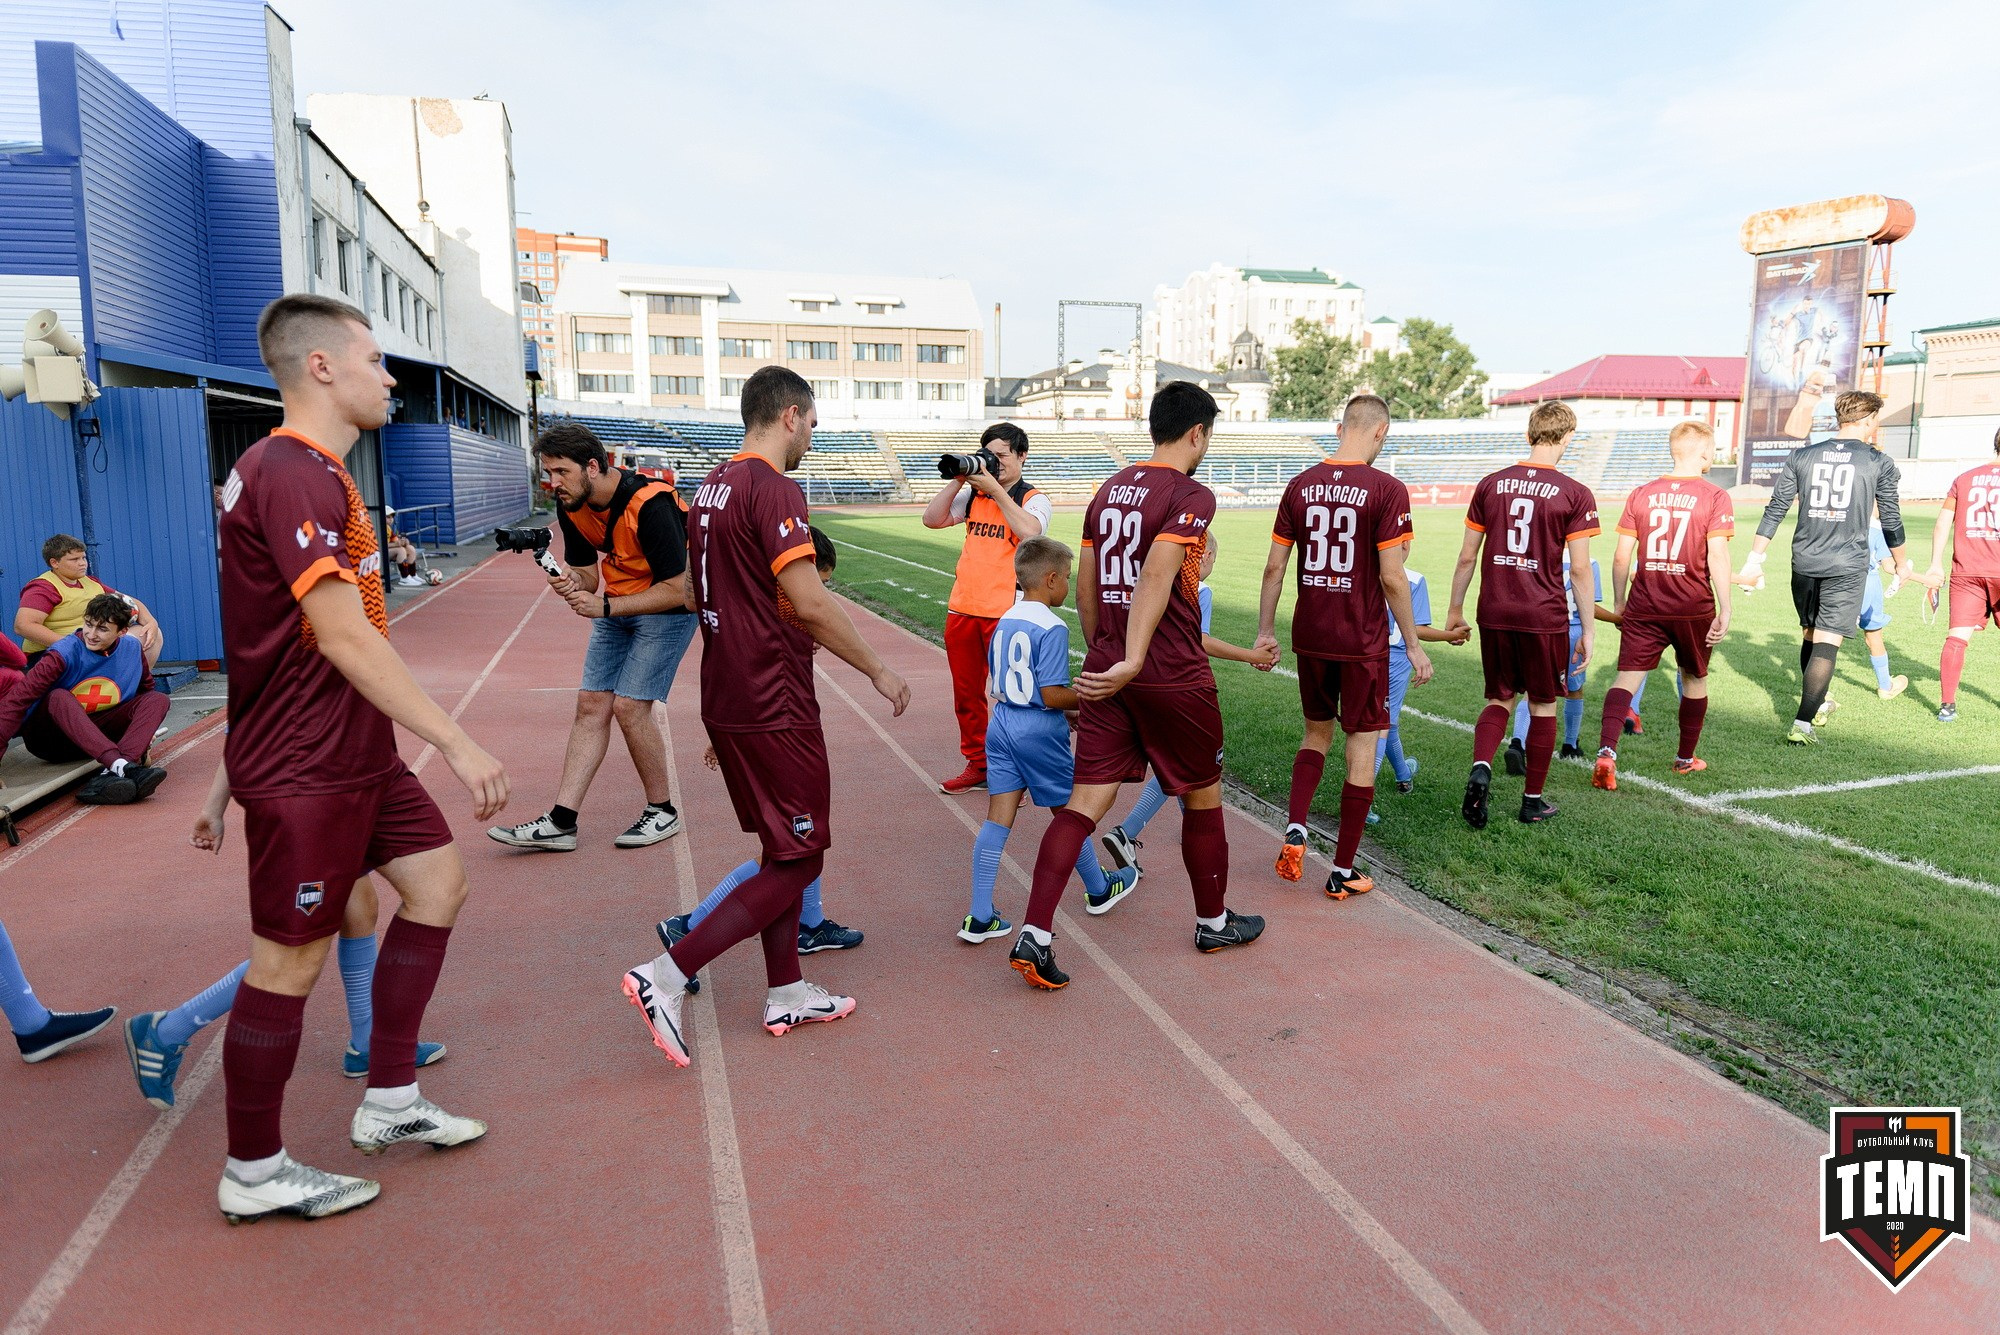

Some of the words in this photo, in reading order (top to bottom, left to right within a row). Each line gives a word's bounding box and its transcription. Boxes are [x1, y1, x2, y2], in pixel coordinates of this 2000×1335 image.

[1752, 440, 1806, 449] ИЗОТОНИК
[1822, 451, 1852, 462] ПАНОВ
[1107, 485, 1150, 507] БАБИЧ
[1301, 484, 1369, 507] ЧЕРКАСОВ
[1496, 478, 1560, 499] ВЕРНИГОР
[1809, 463, 1856, 509] 59
[1648, 492, 1698, 510] ЖДАНОВ
[1808, 509, 1848, 519] SEUS
[1507, 498, 1535, 555] 3
[1646, 508, 1692, 561] 27
[1099, 507, 1143, 587] 22
[1304, 505, 1357, 573] 33
[1493, 554, 1538, 570] SEUS
[1644, 561, 1686, 573] SEUS
[1302, 574, 1352, 589] SEUS
[1102, 590, 1133, 604] SEU
[991, 630, 1034, 705] 18
